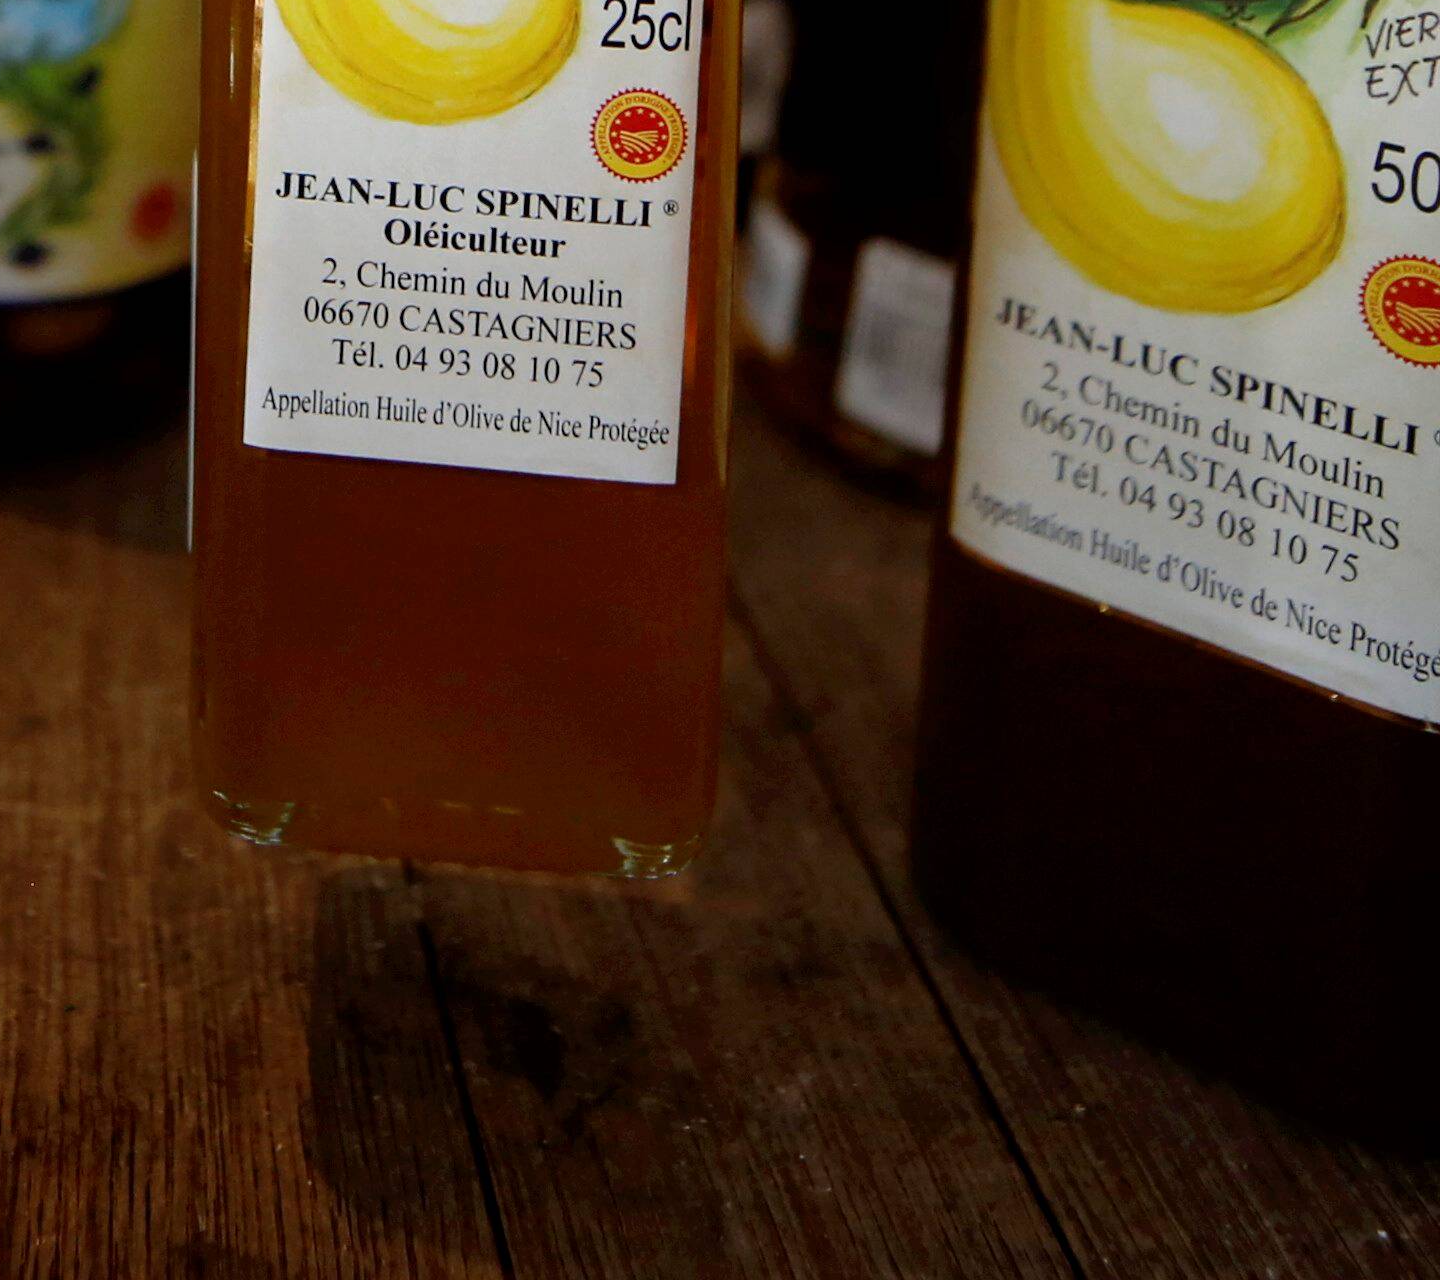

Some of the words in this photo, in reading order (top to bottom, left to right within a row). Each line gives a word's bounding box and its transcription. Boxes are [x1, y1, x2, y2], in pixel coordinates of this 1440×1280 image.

[275, 171, 465, 214] JEAN-LUC
[475, 188, 652, 228] SPINELLI
[383, 216, 567, 259] Oléiculteur
[321, 257, 346, 289] 2,
[355, 260, 466, 298] Chemin
[476, 269, 510, 300] du
[520, 273, 623, 308] Moulin
[304, 295, 389, 330] 06670
[398, 304, 637, 351] CASTAGNIERS
[331, 338, 384, 371] Tél.
[395, 344, 428, 373] 04
[438, 348, 472, 377] 93
[482, 351, 516, 381] 08
[528, 355, 560, 384] 10
[571, 359, 604, 388] 75
[996, 296, 1200, 385] JEAN-LUC
[1209, 363, 1421, 456] SPINELLI
[262, 385, 370, 426] Appellation
[376, 395, 428, 426] Huile
[510, 406, 532, 435] de
[537, 409, 582, 439] Nice
[587, 414, 670, 449] Protégée
[1040, 360, 1069, 401] 2,
[1078, 374, 1201, 439] Chemin
[1211, 410, 1252, 456] du
[1262, 429, 1385, 498] Moulin
[1022, 397, 1115, 456] 06670
[1125, 439, 1402, 552] CASTAGNIERS
[1051, 451, 1109, 500] Tél.
[1119, 477, 1157, 514] 04
[1167, 492, 1204, 528] 93
[1217, 510, 1254, 547] 08
[1272, 527, 1307, 566] 10
[1321, 545, 1359, 584] 75
[966, 481, 1084, 554] Appellation
[1089, 527, 1151, 576] Huile
[1251, 587, 1279, 622] de
[1286, 599, 1342, 644] Nice
